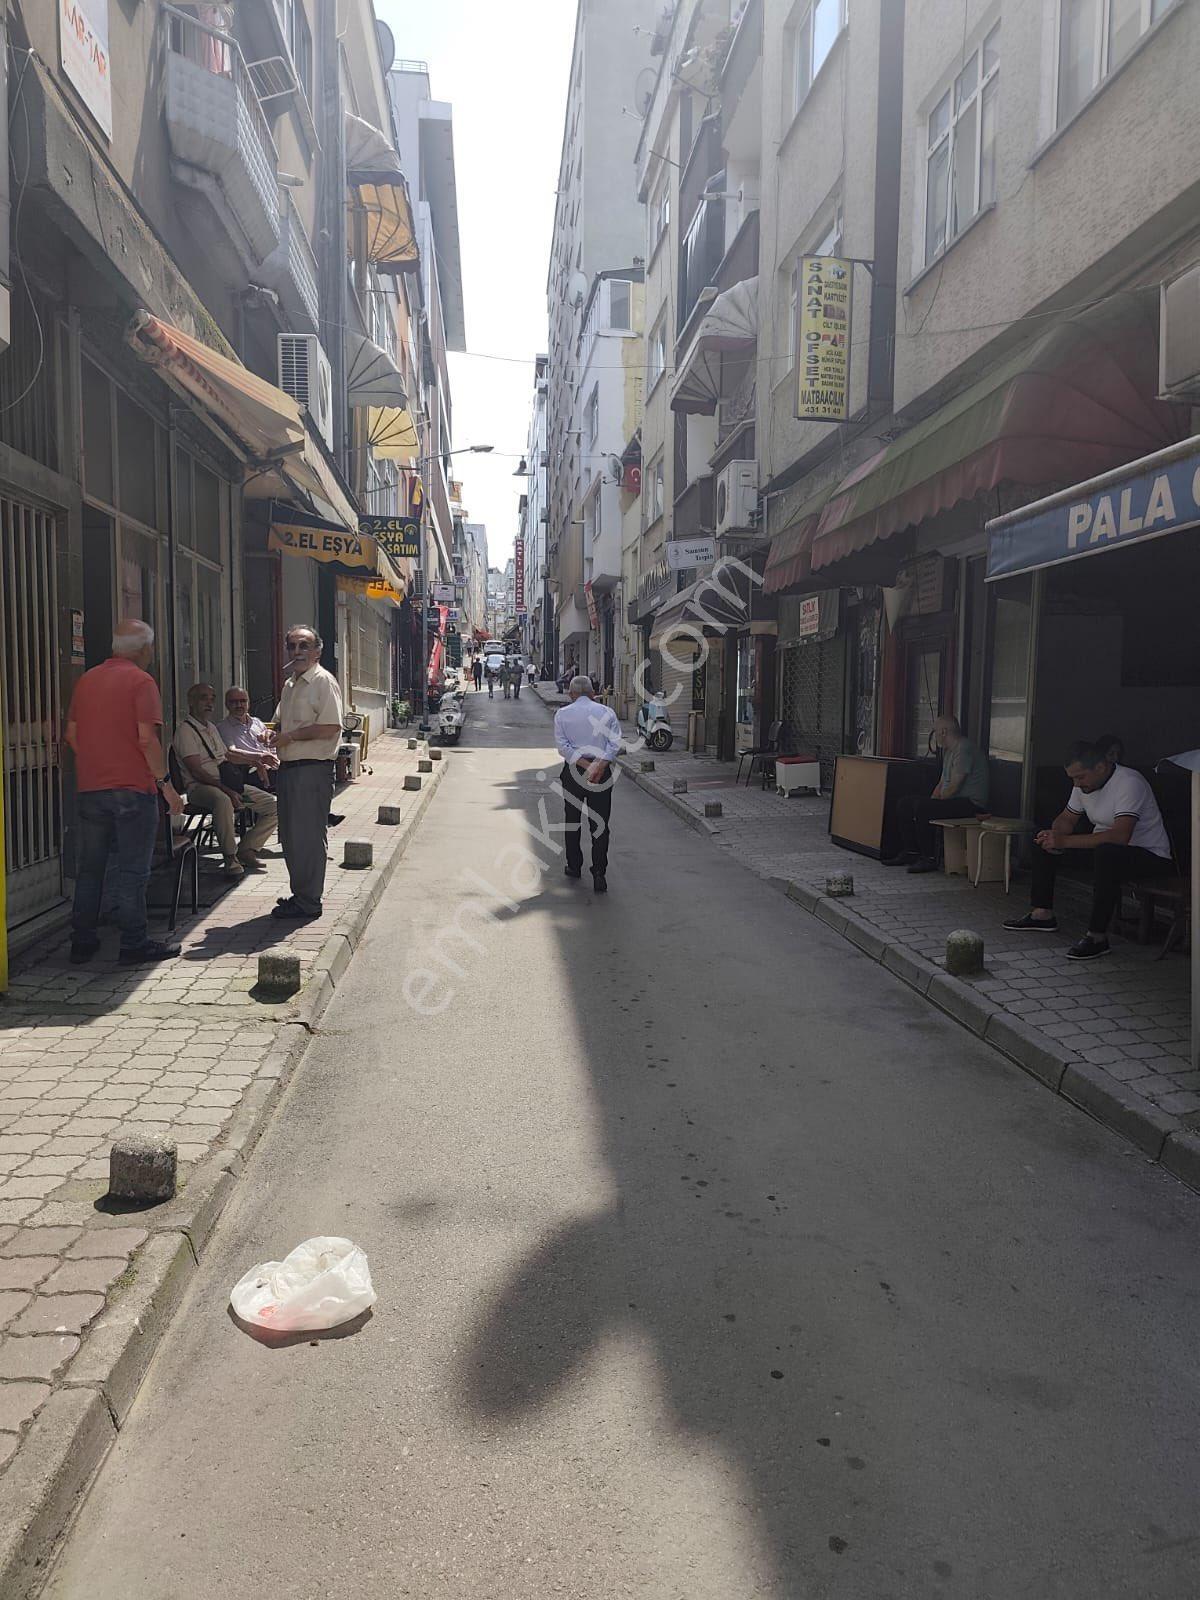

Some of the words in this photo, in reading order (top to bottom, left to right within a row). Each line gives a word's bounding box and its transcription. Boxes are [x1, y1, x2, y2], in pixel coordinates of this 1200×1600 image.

[806, 262, 823, 319] SANAT
[804, 331, 821, 388] OFSET
[801, 389, 845, 407] MATBAACILIK
[1067, 474, 1176, 549] PALA
[373, 519, 403, 530] 2.EL
[284, 532, 318, 550] 2.EL
[322, 535, 363, 556] EŞYA
[387, 543, 419, 555] SATIM
